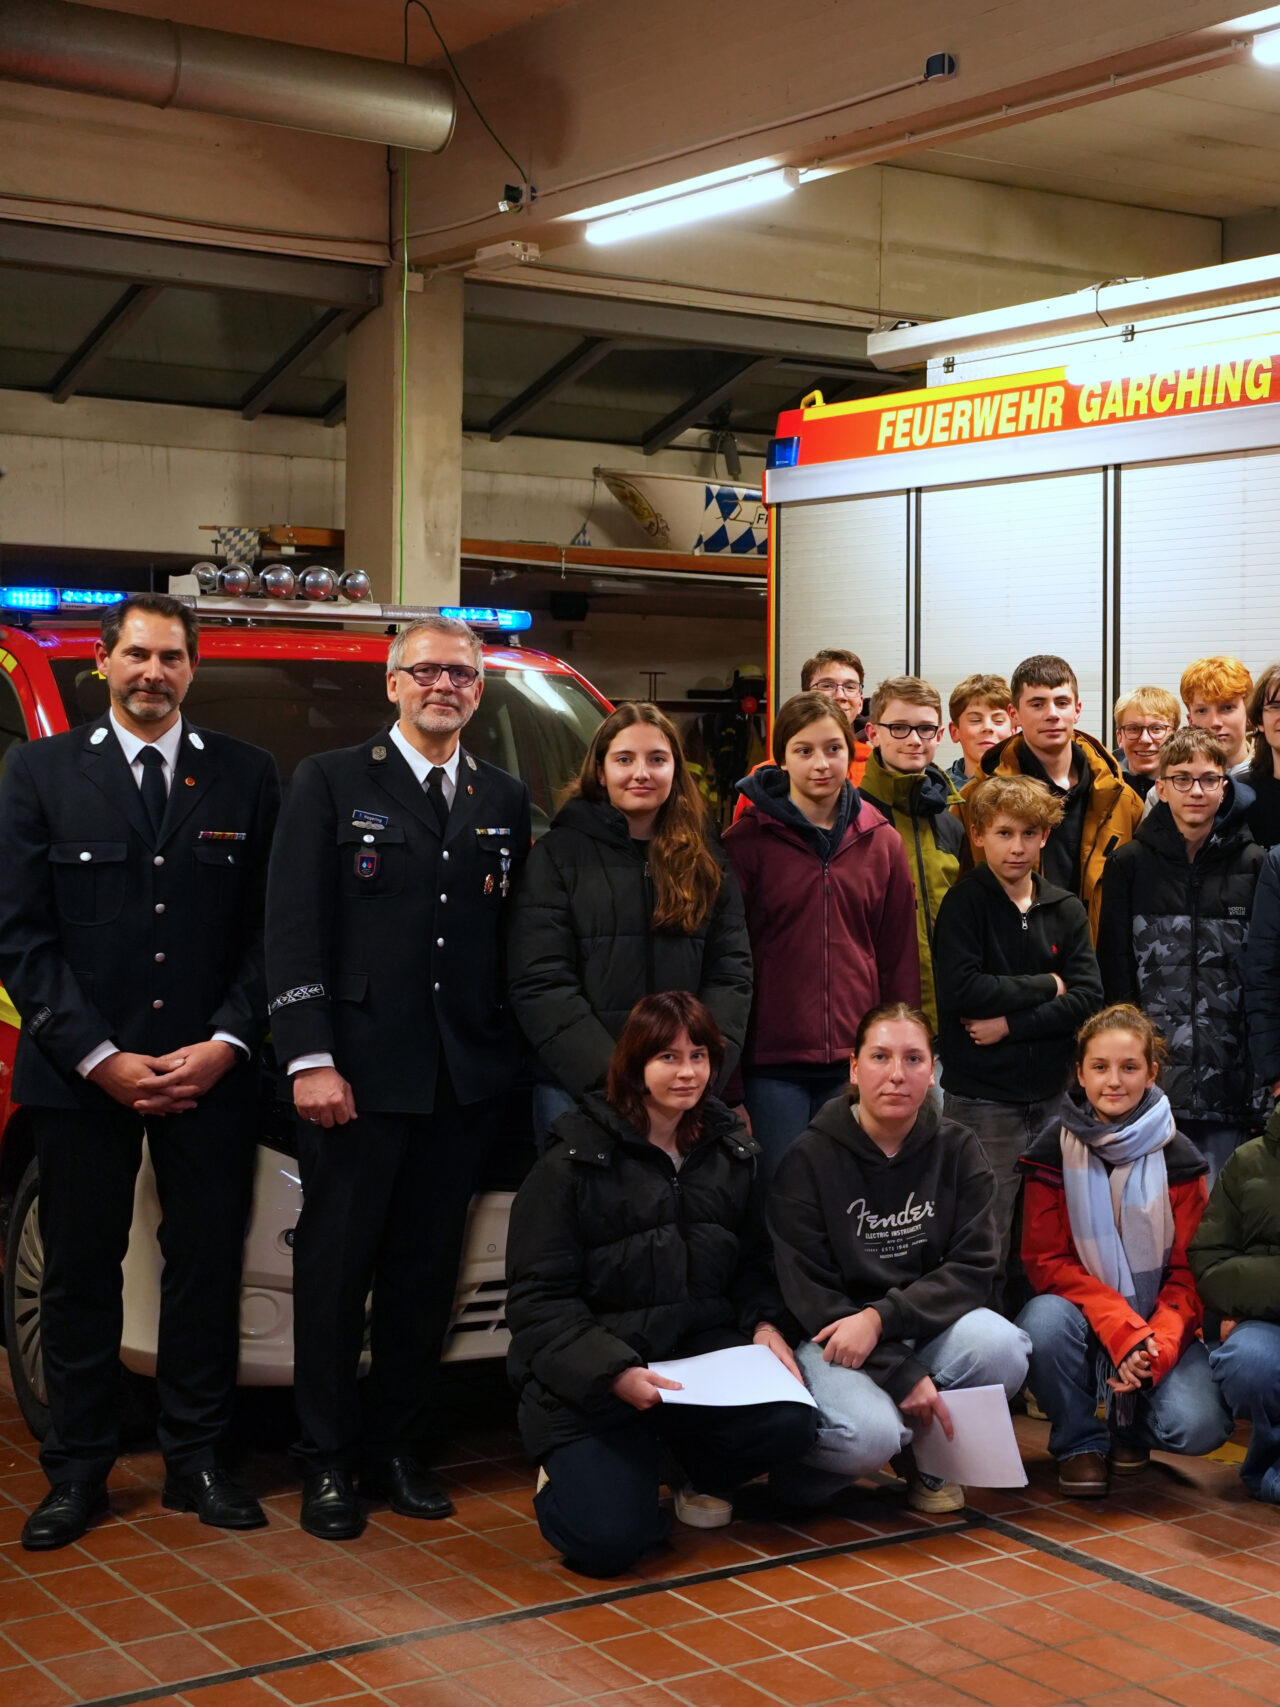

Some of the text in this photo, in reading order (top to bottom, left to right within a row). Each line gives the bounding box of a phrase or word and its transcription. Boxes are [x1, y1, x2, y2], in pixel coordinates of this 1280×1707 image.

[877, 356, 1273, 450] FEUERWEHR GARCHING
[847, 1192, 935, 1237] Fender
[865, 1224, 922, 1239] ELECTRIC INSTRUMENT
